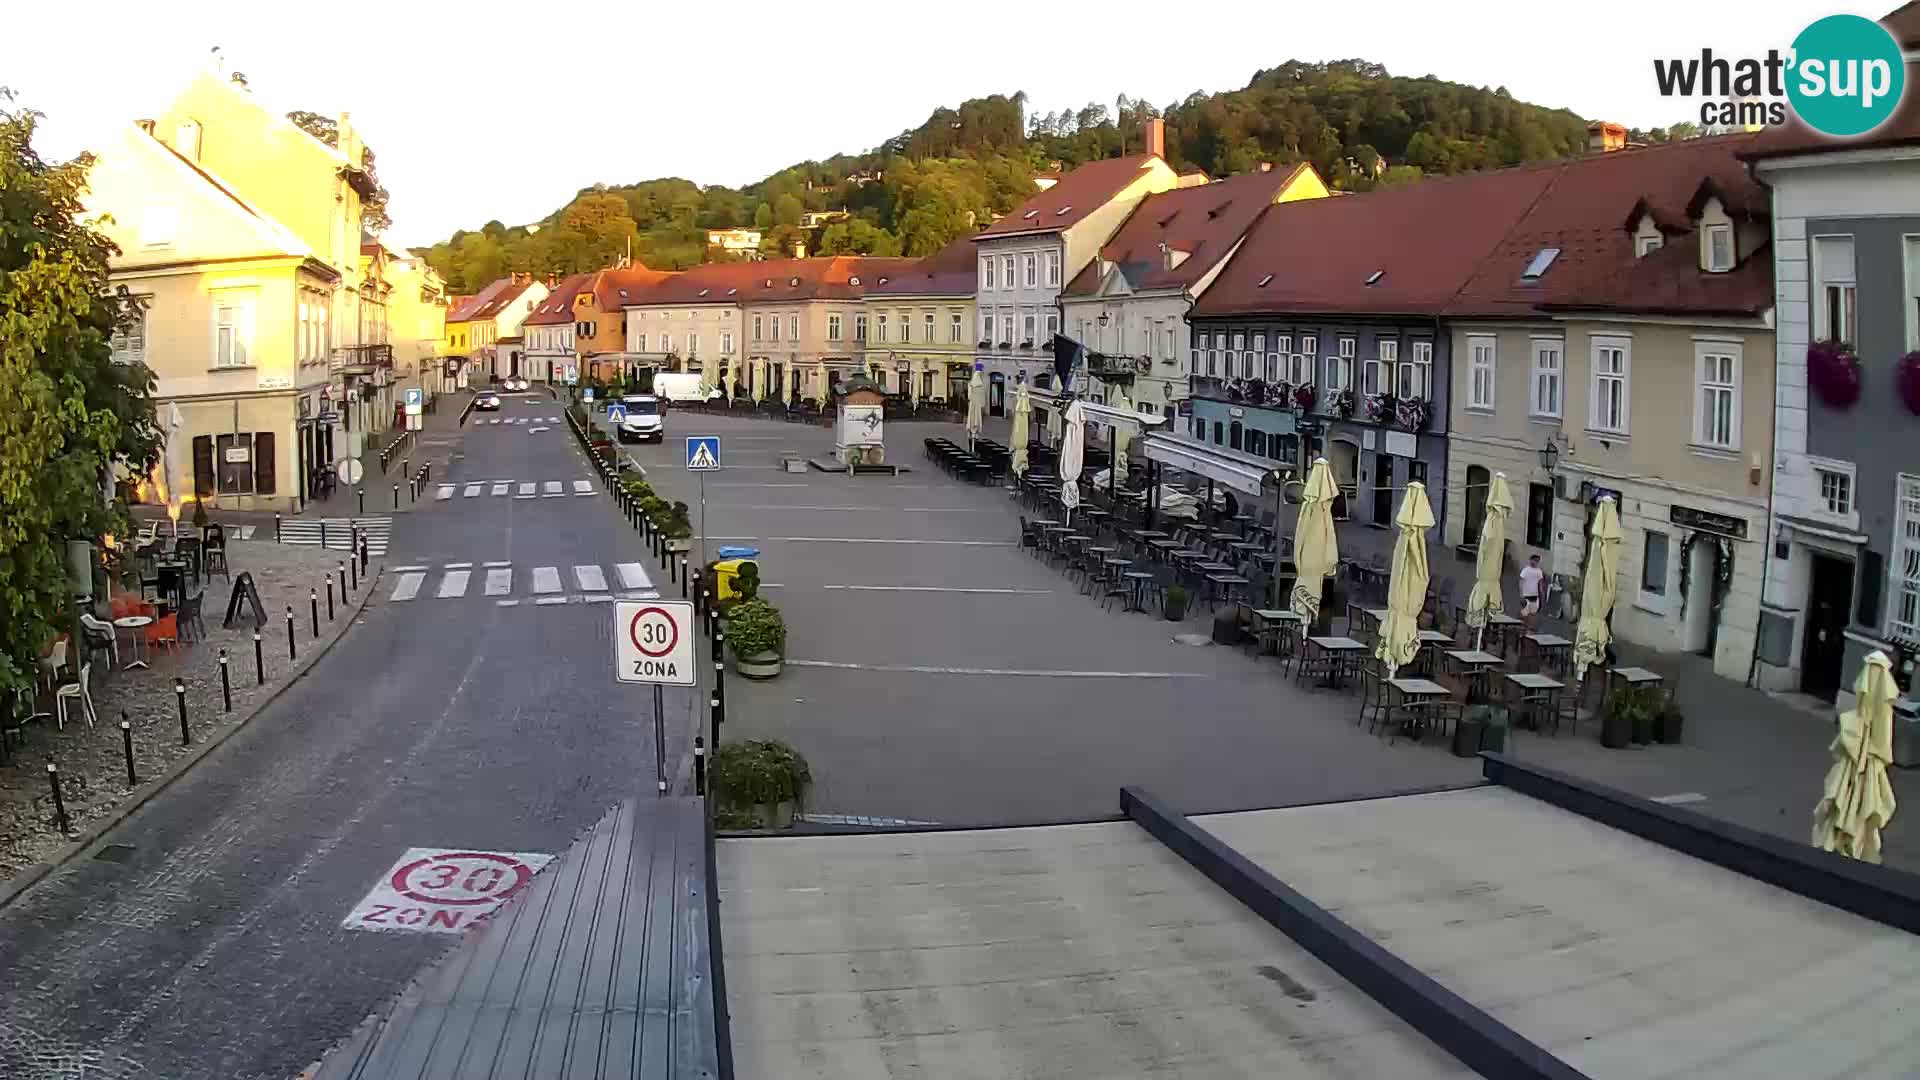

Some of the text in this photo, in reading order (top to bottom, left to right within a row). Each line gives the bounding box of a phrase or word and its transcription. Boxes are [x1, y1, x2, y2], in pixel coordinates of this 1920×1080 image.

[643, 623, 667, 644] 30
[633, 661, 677, 677] ZONA
[420, 865, 505, 892] 30
